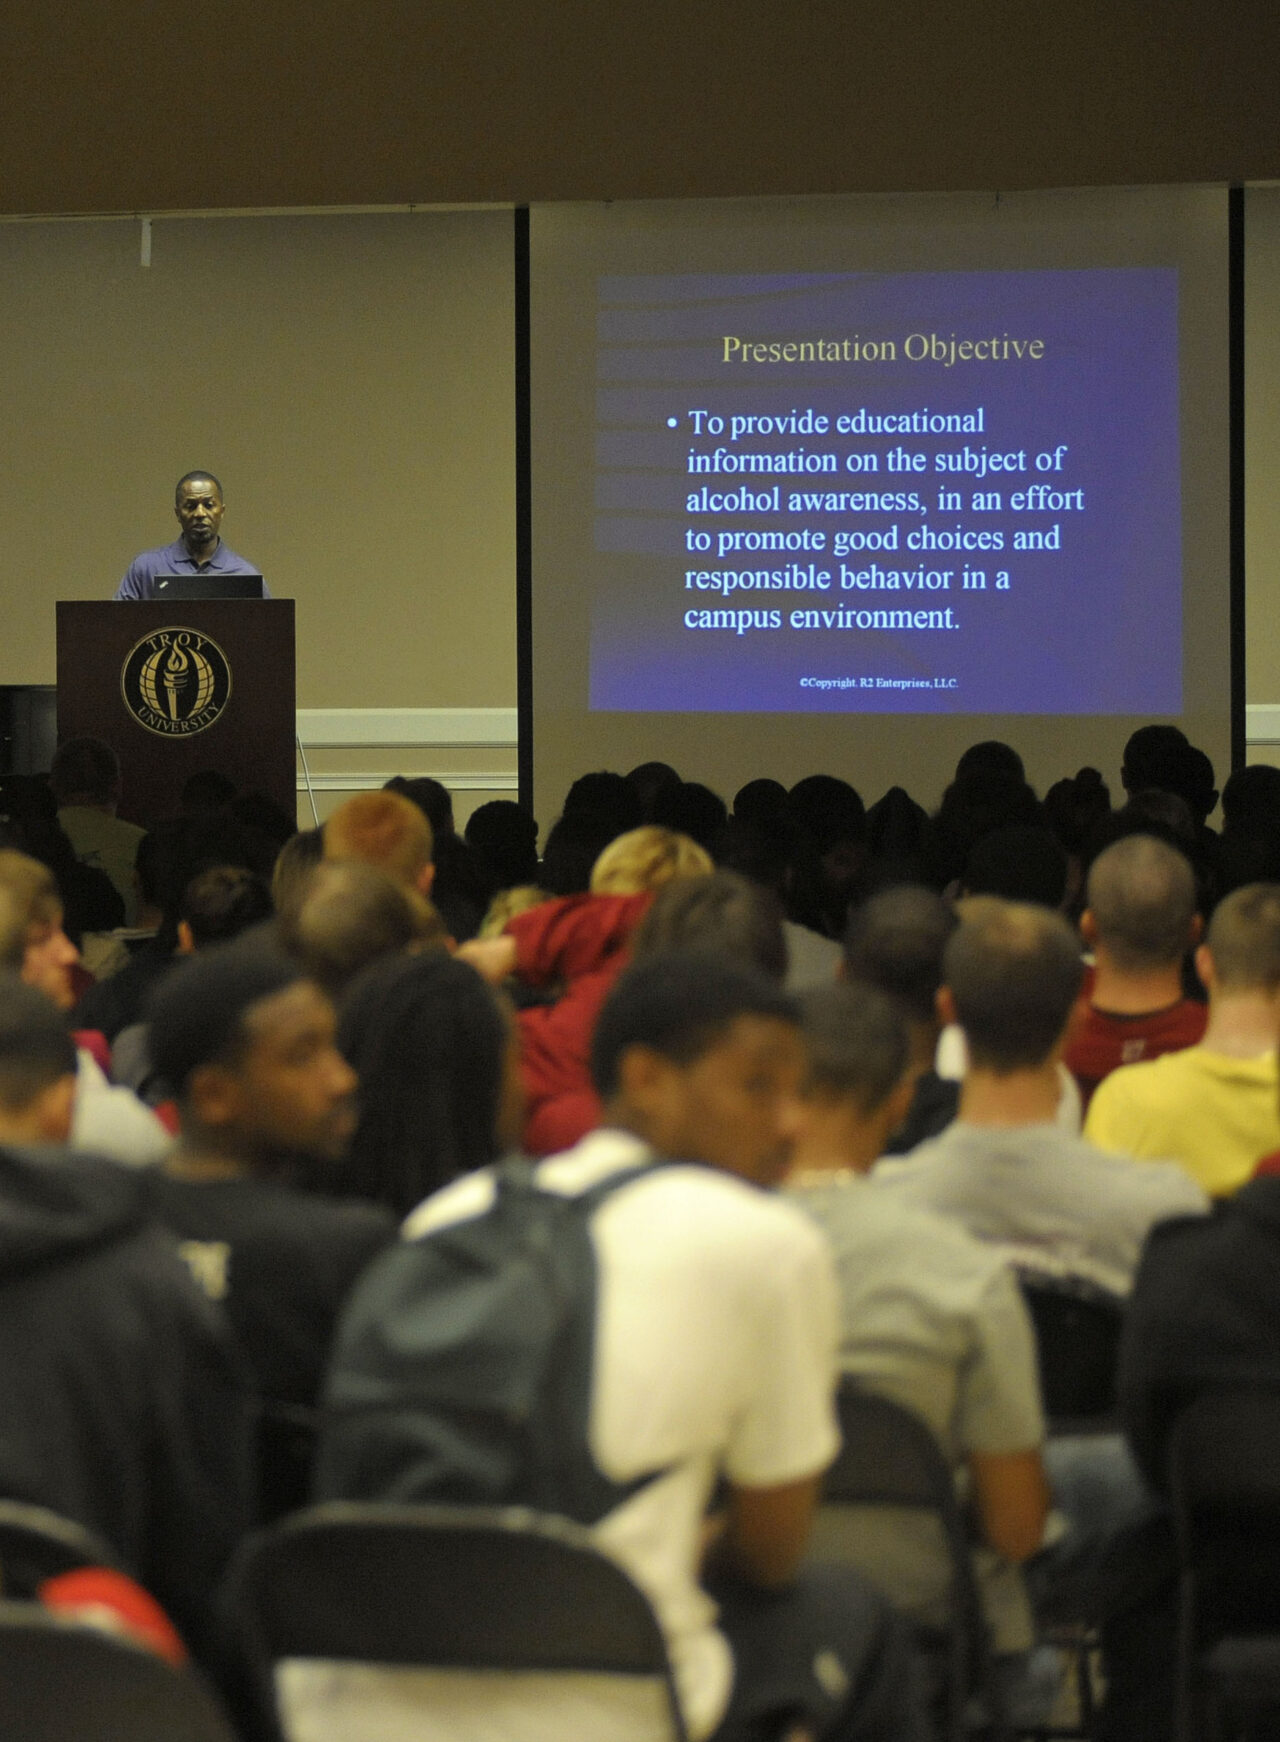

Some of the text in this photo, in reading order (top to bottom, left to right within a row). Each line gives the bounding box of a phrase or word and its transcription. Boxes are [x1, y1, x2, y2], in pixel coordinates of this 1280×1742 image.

[722, 333, 1044, 367] Presentation Objective
[688, 407, 984, 440] To provide educational
[687, 445, 1069, 478] information on the subject of
[686, 485, 1085, 516] alcohol awareness, in an effort
[685, 524, 1061, 558] to promote good choices and
[684, 563, 1011, 596] responsible behavior in a
[684, 602, 960, 635] campus environment.
[146, 632, 208, 651] TROY
[860, 677, 874, 688] R2
[876, 677, 933, 690] Enterprises,
[138, 702, 220, 733] UNIVERSITY
